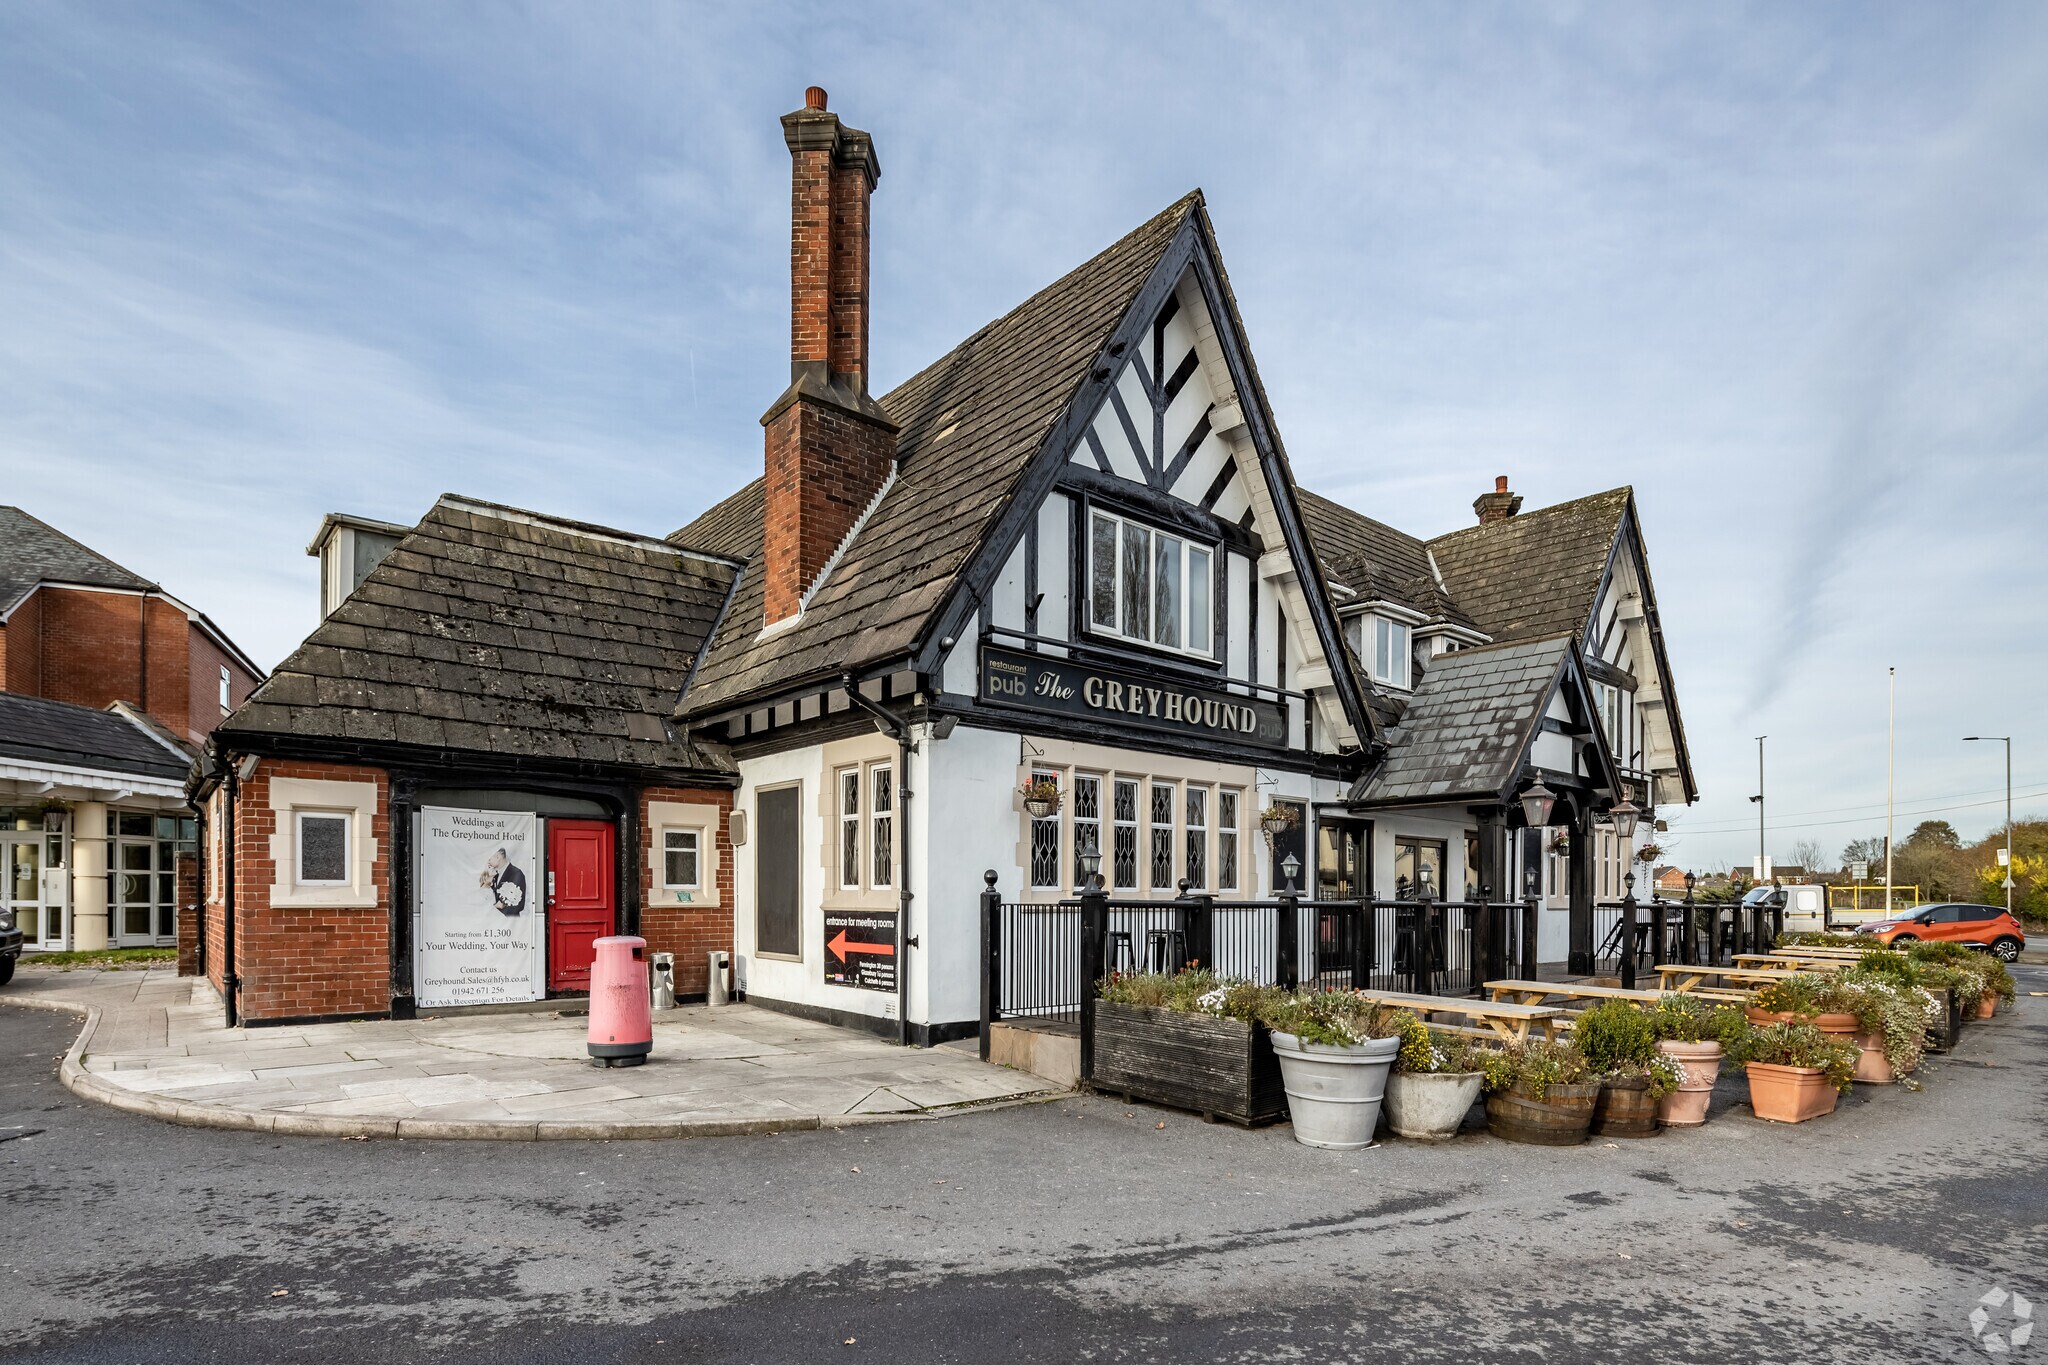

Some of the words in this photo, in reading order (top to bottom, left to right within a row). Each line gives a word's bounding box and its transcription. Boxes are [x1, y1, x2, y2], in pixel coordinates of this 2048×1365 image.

[989, 660, 1027, 673] restaurant
[990, 676, 1026, 696] pub
[1035, 671, 1075, 700] The
[1083, 676, 1257, 733] GREYHOUND
[1259, 723, 1283, 739] pub
[452, 816, 494, 829] Weddings
[496, 819, 505, 828] at
[432, 828, 449, 837] The
[451, 829, 500, 841] Greyhound
[502, 832, 525, 841] Hotel
[826, 917, 847, 926] entrance
[848, 917, 856, 926] for
[856, 918, 877, 929] meeting
[878, 920, 895, 928] rooms
[444, 931, 467, 939] Starting
[484, 929, 512, 938] £1,300
[426, 942, 446, 950] Your
[448, 941, 488, 951] Wedding,
[490, 941, 509, 950] Your
[511, 941, 528, 950] Way
[460, 966, 487, 974] Contact
[424, 975, 530, 987] Greyhound.Sales@hfyh.co.uk
[451, 987, 474, 995] 01942
[492, 986, 505, 994] 256
[454, 998, 490, 1006] Reception
